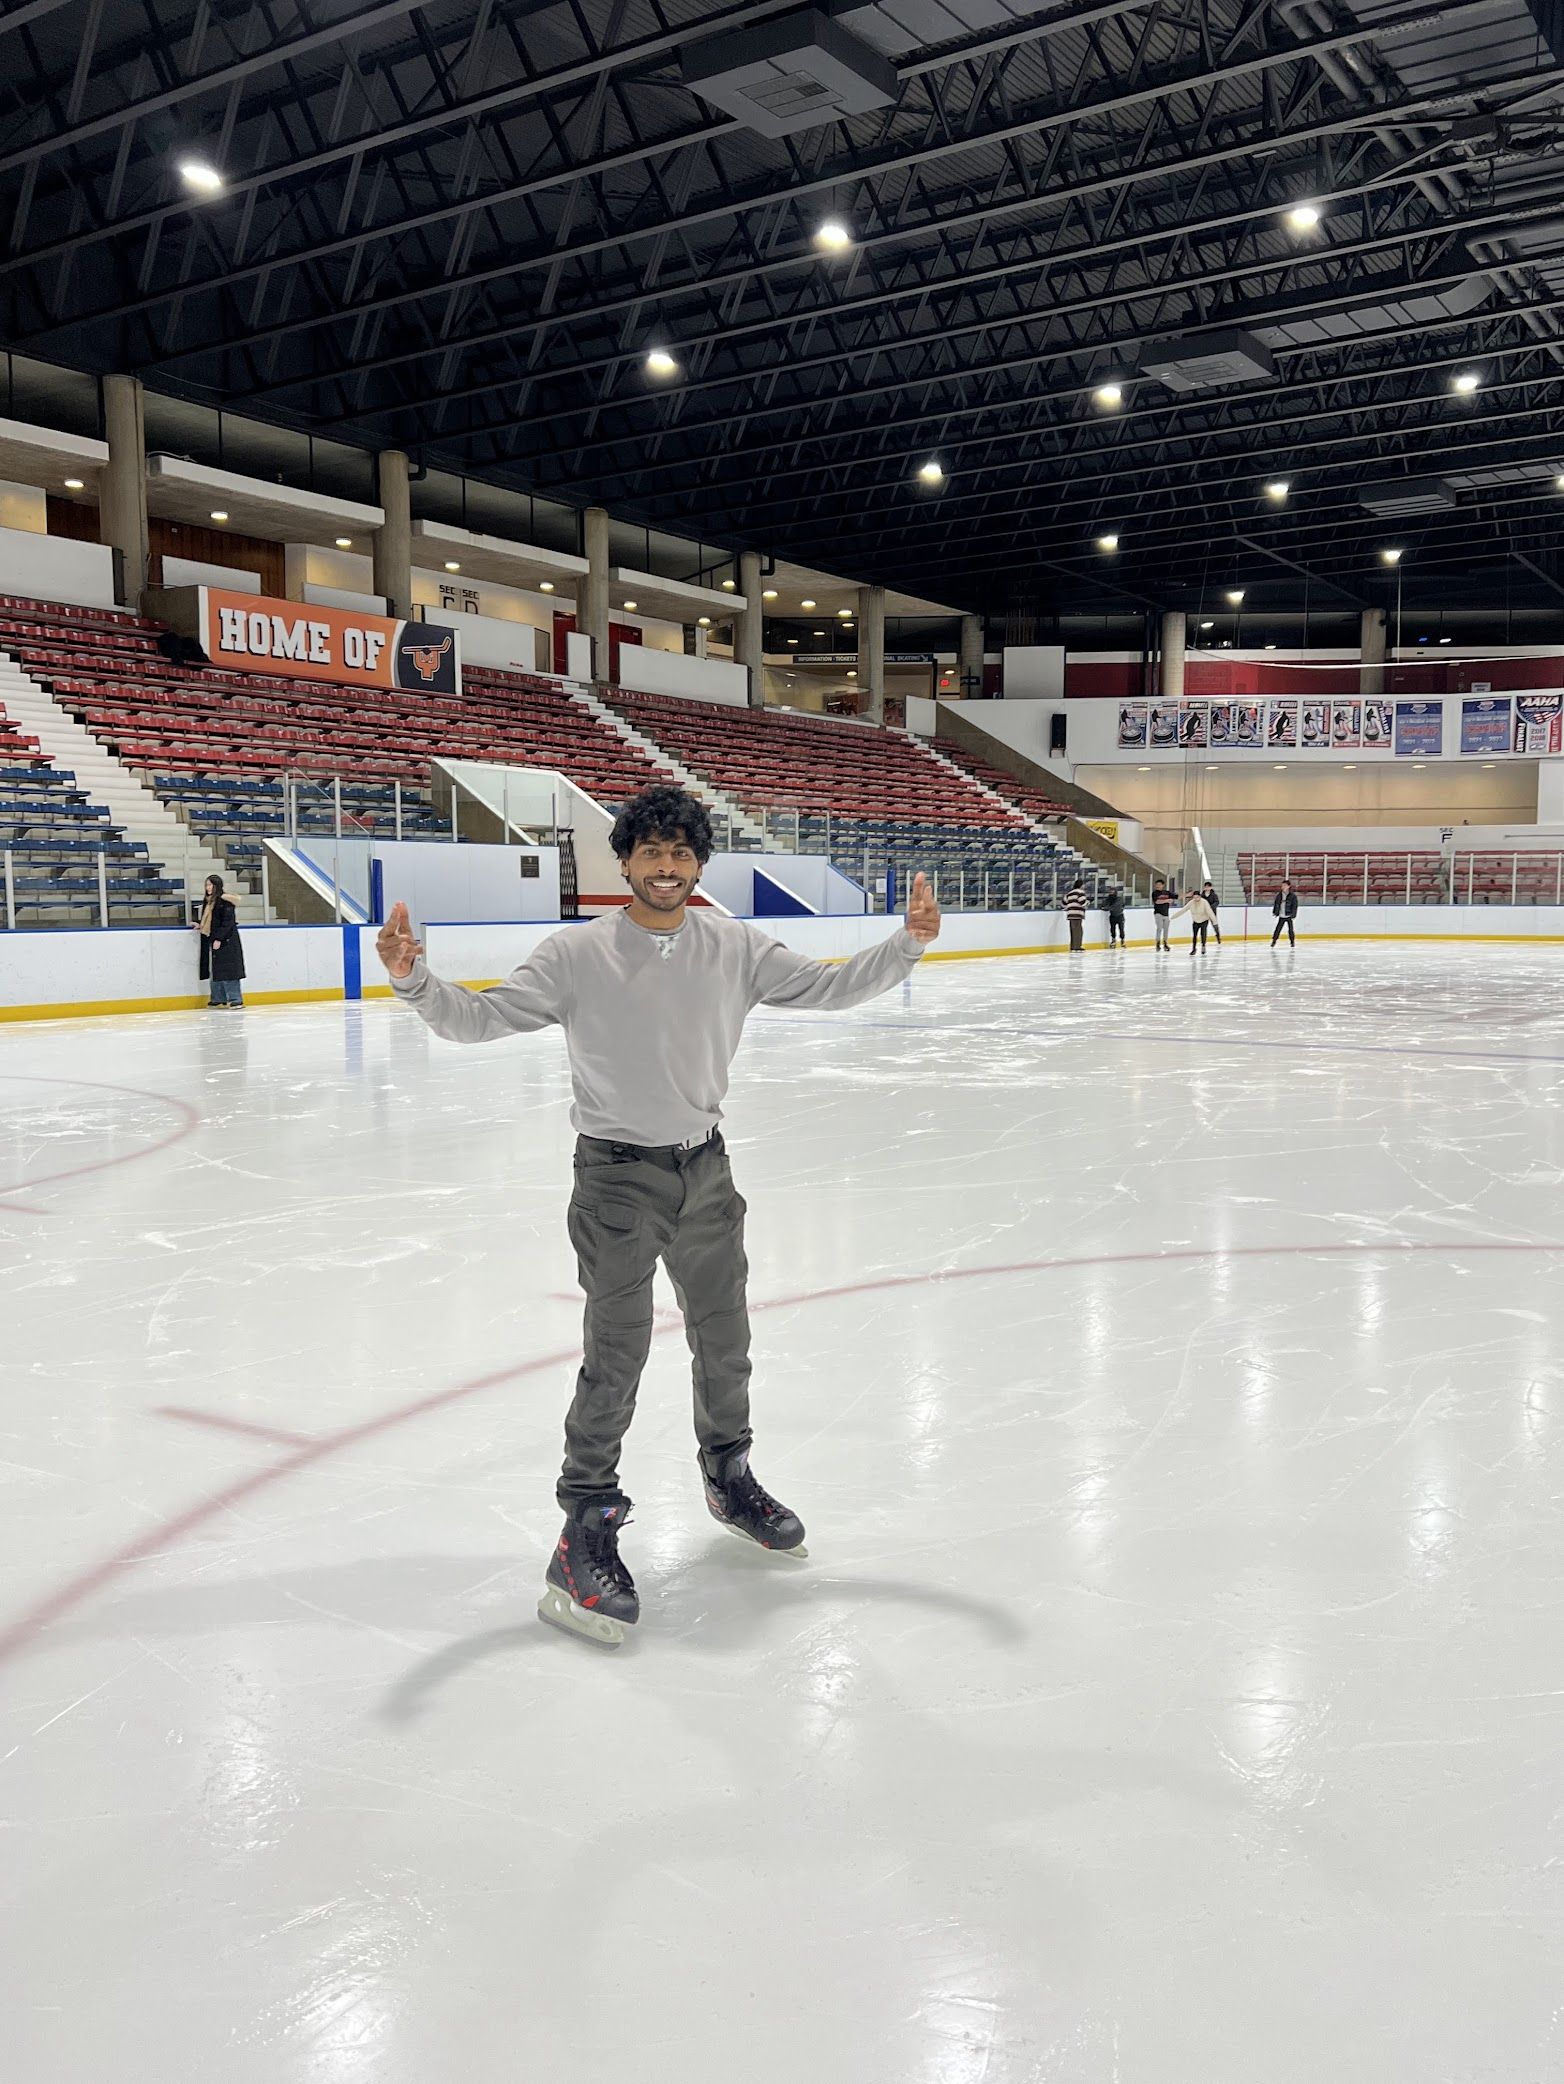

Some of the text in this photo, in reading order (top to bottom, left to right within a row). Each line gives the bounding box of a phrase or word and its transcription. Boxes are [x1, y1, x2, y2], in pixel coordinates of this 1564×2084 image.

[439, 584, 457, 595] SEC
[462, 589, 479, 600] SEC
[219, 608, 386, 670] HOME OF
[1520, 696, 1559, 707] AAHA
[1516, 722, 1526, 752] FINALIST
